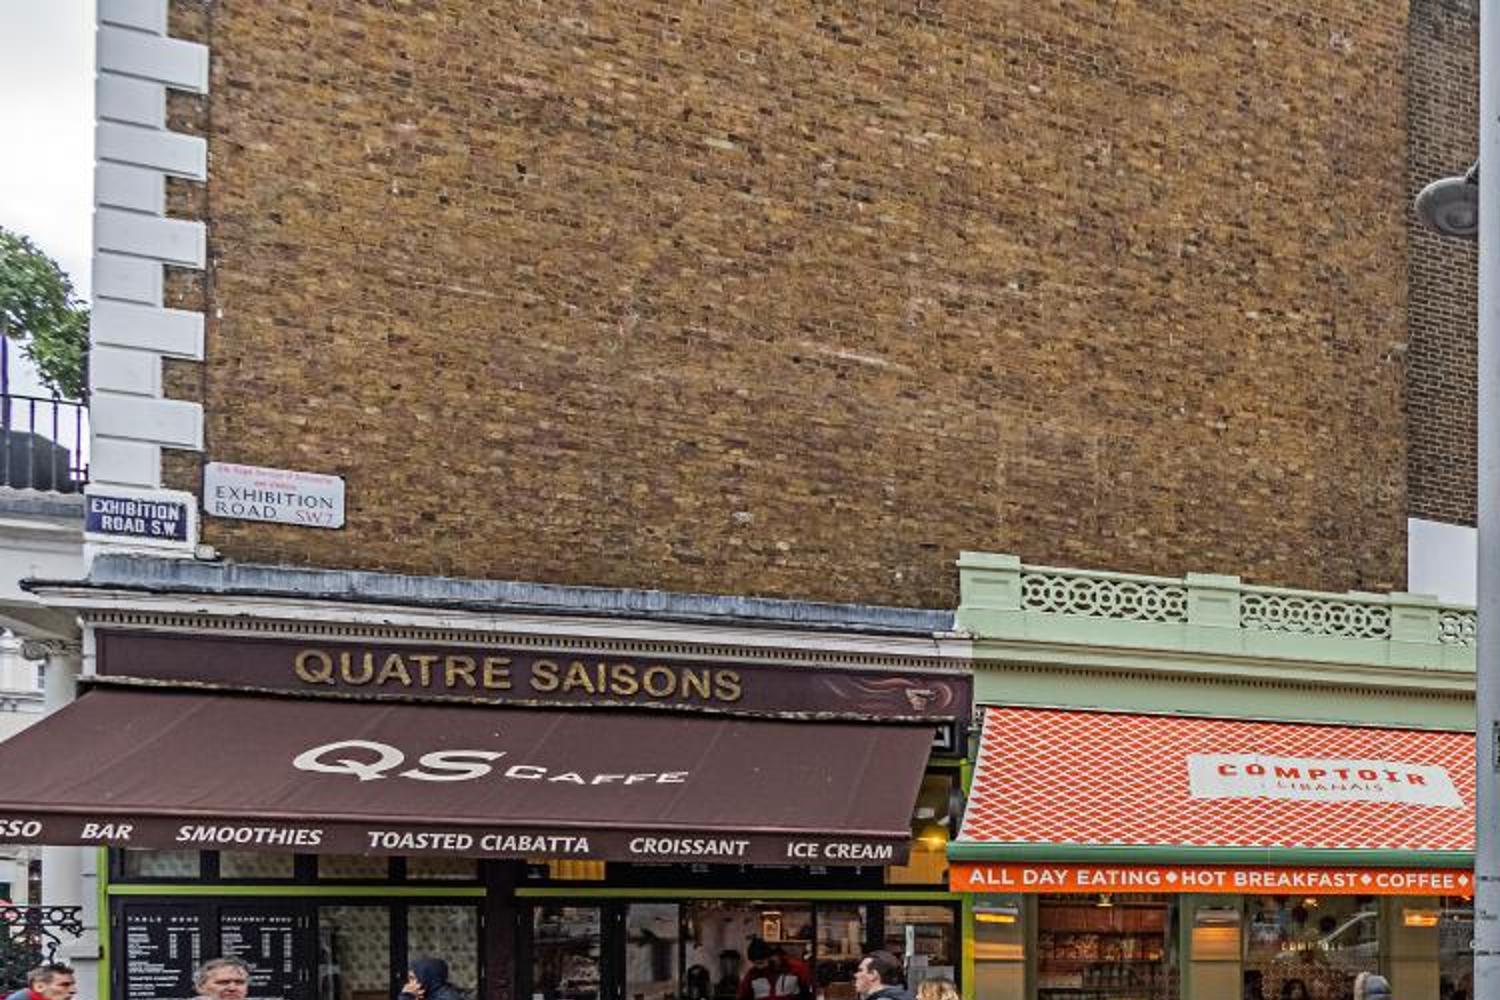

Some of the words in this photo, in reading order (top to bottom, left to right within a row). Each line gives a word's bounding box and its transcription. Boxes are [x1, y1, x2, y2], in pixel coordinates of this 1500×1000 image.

[91, 498, 180, 520] EXHIBITION
[216, 485, 334, 510] EXHIBITION
[216, 504, 278, 520] ROAD
[295, 649, 512, 690] QUATRE
[529, 660, 743, 701] SAISONS
[293, 739, 507, 781] QS
[504, 764, 690, 785] CAFFE
[1217, 764, 1428, 787] COMPTOIR
[1276, 780, 1384, 793] LIBANAIS
[81, 824, 133, 840] BAR
[176, 826, 323, 846] SMOOTHIES
[368, 832, 474, 850] TOASTED
[480, 834, 590, 853] CIABATTA
[629, 837, 750, 856] CROISSANT
[787, 842, 819, 858] ICE
[824, 843, 893, 859] CREAM
[969, 868, 1015, 885] ALL
[1023, 869, 1069, 885] DAY
[1077, 870, 1161, 886] EATING
[1182, 871, 1227, 887] HOT
[1234, 871, 1358, 888] BREAKFAST
[1375, 873, 1455, 889] COFFEE
